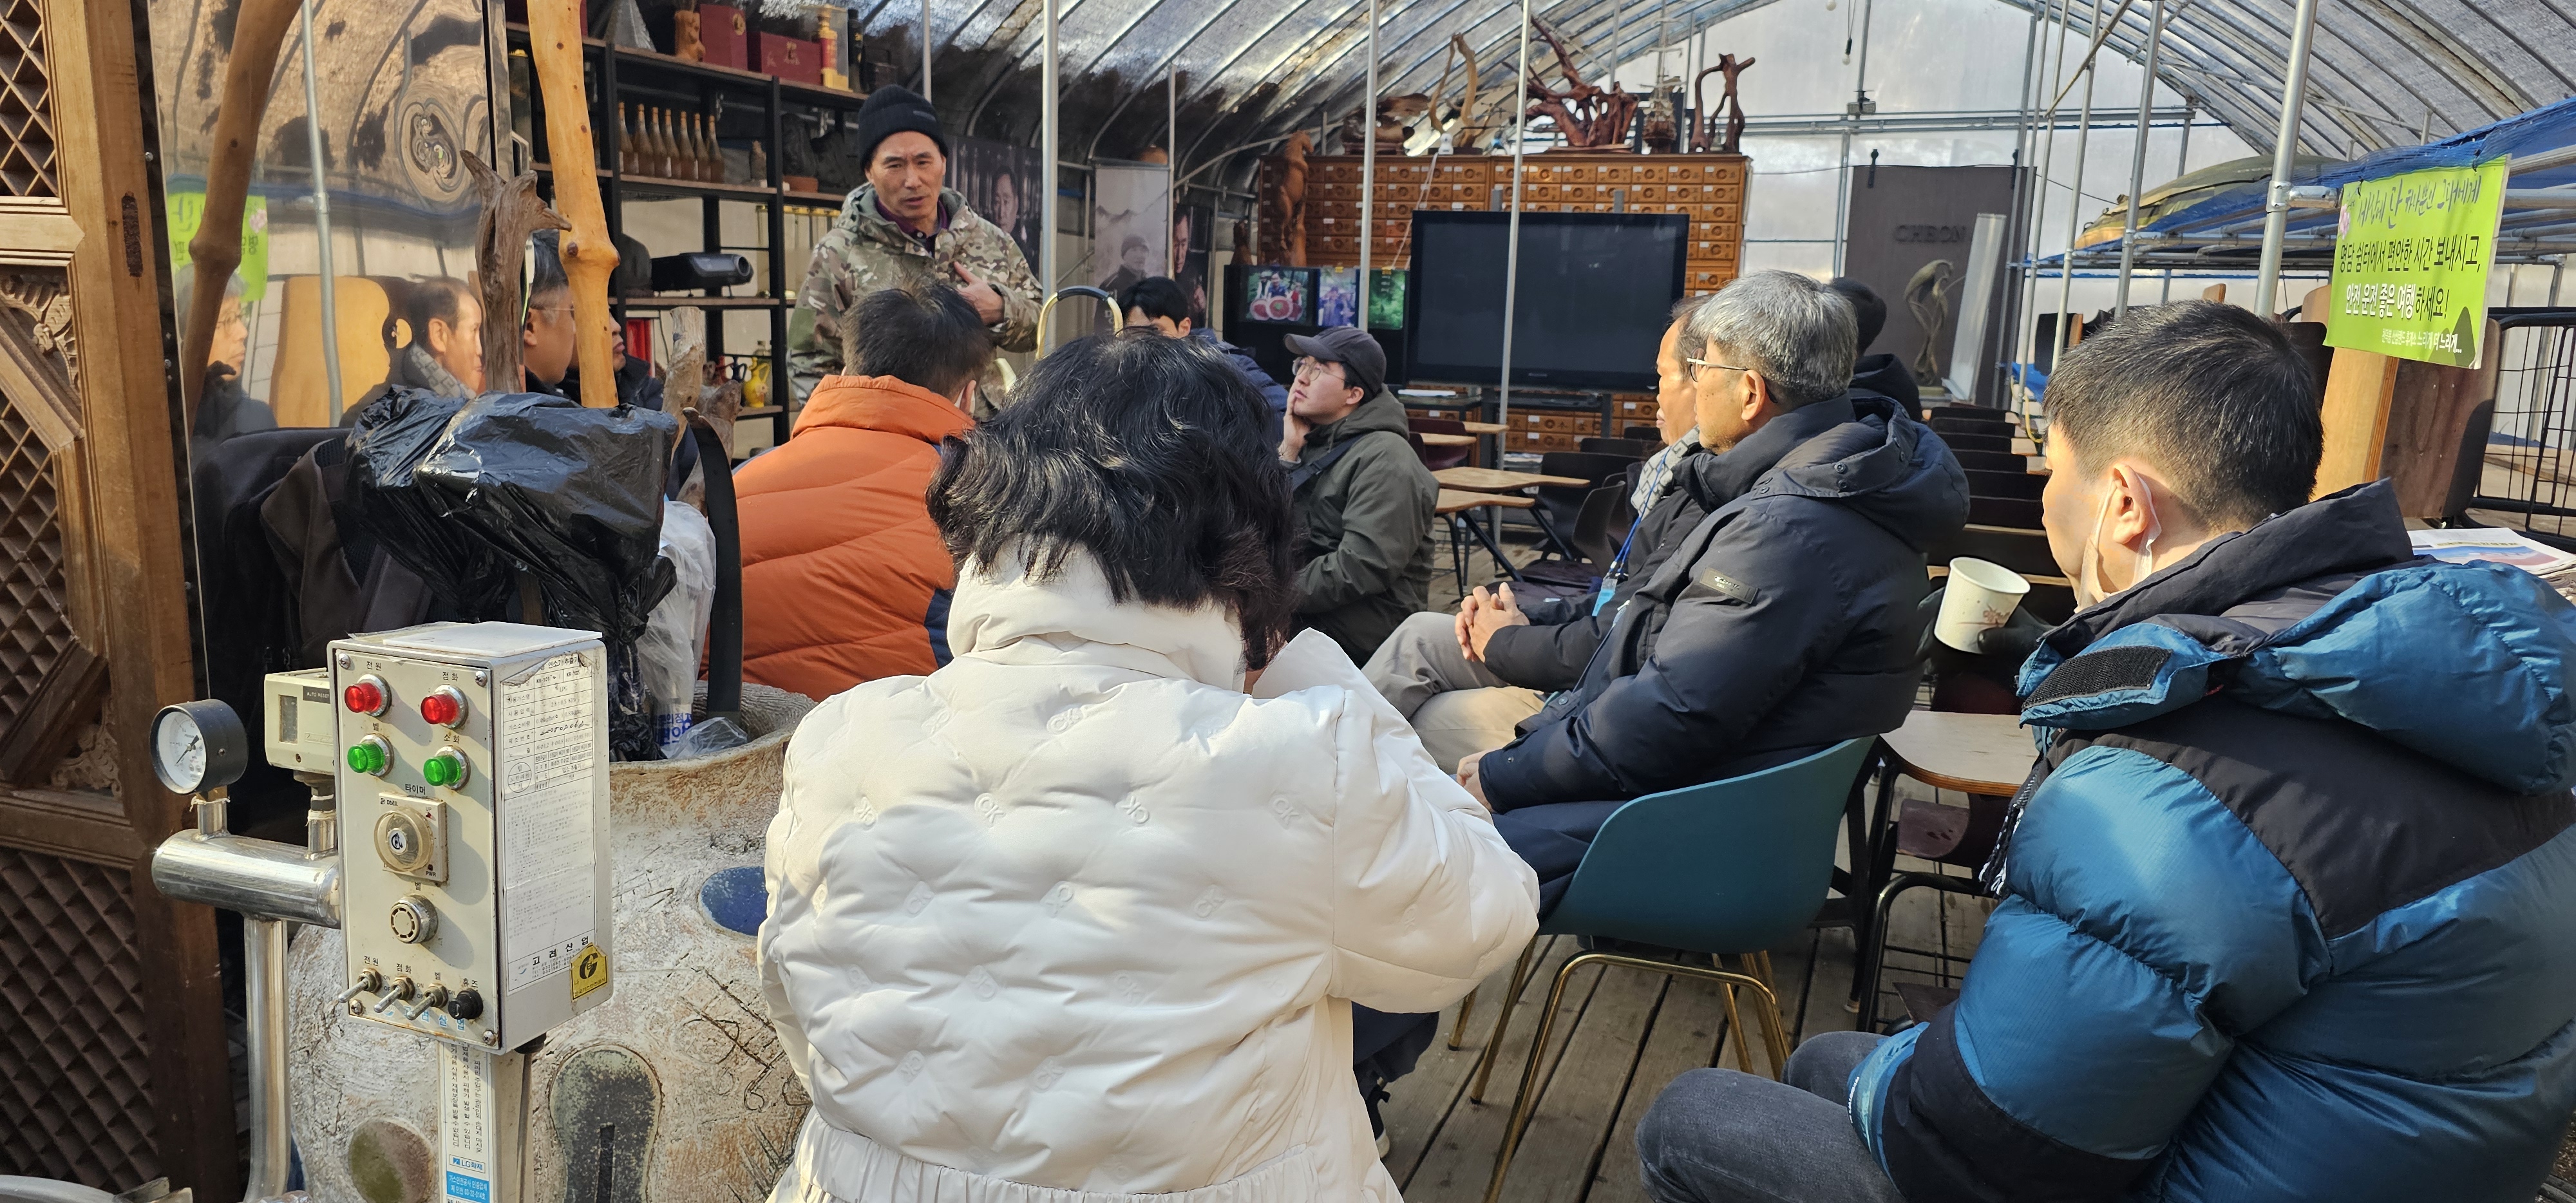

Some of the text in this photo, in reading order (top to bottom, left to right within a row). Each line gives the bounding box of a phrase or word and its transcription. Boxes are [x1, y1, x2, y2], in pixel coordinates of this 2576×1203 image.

[2356, 240, 2387, 272] 쉼터에서
[2387, 237, 2412, 272] 편안한
[2413, 236, 2434, 272] 시간
[2434, 233, 2481, 273] 보내시고,
[2345, 283, 2362, 315] 안전
[2362, 283, 2379, 316] 운전
[2379, 283, 2395, 319] 좋은
[2433, 332, 2440, 351] 더
[366, 661, 382, 671] 전원
[442, 671, 459, 681] 점화
[372, 722, 379, 732] 벨
[443, 734, 460, 744] 소화
[404, 783, 426, 795] 타이머
[977, 795, 1006, 825] CK
[364, 955, 379, 967] 전원
[396, 963, 412, 974] 점화
[434, 971, 441, 981] 벨
[462, 978, 478, 989] 휴즈
